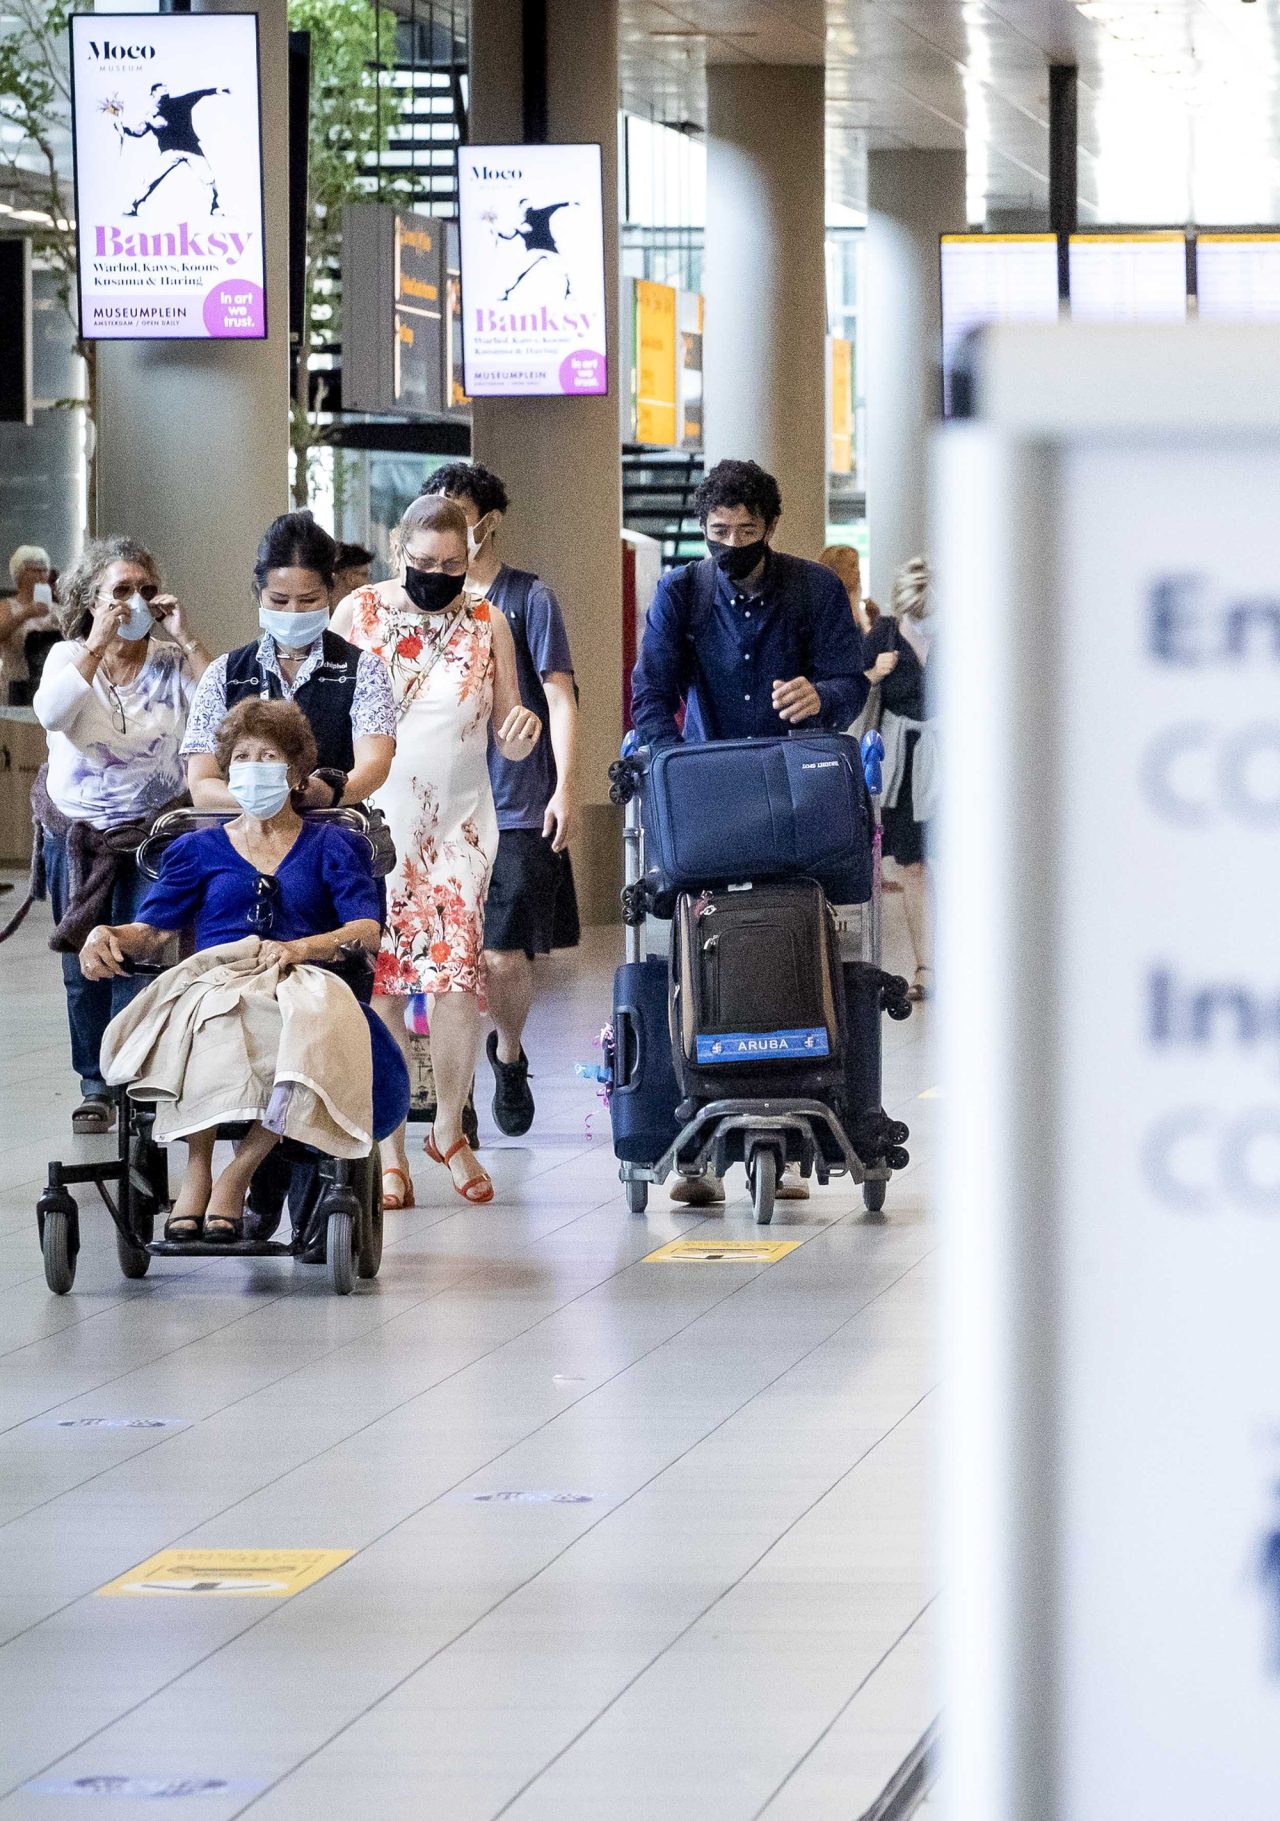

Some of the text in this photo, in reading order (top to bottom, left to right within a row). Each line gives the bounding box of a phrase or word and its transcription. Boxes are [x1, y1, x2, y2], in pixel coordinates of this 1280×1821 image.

[88, 41, 156, 60] Moco
[470, 166, 522, 181] Moco
[94, 222, 253, 265] Banksy
[93, 263, 219, 272] Warhol, Kaws, Koons
[94, 276, 203, 286] Kusama & Haring
[220, 292, 254, 305] In art
[93, 307, 187, 318] MUSEUMPLEIN
[228, 306, 248, 316] we
[224, 316, 255, 328] trust.
[475, 306, 596, 337] Banksy
[738, 1039, 788, 1051] ARUBA
